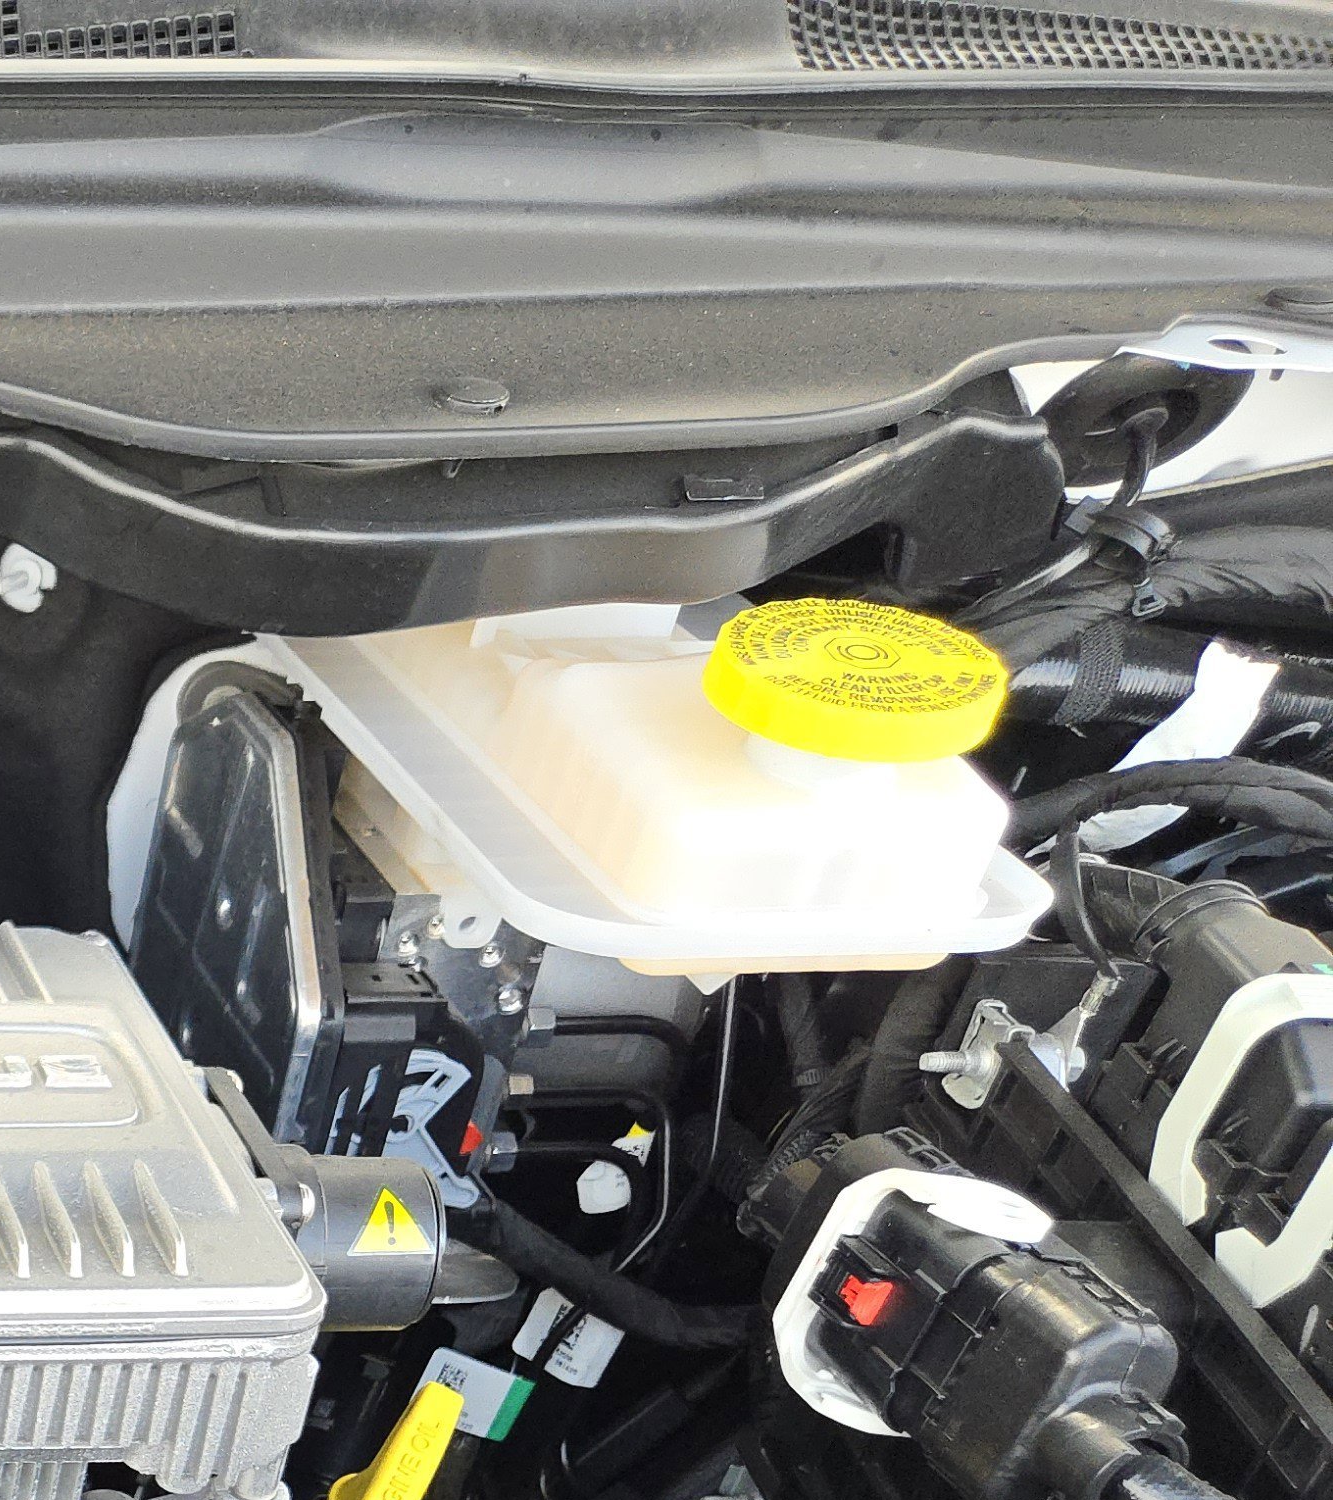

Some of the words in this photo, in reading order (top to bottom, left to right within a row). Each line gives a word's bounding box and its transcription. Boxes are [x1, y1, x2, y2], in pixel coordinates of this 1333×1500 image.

[824, 599, 897, 615] BOUCHON
[792, 616, 820, 629] DOT
[832, 616, 925, 644] PROVENANT
[823, 608, 889, 623] UTILISER
[892, 617, 968, 657] UNIQUEMENT
[783, 673, 843, 698] BEFORE
[936, 685, 961, 699] USE
[951, 671, 975, 688] ONLY
[820, 677, 871, 695] CLEAN
[876, 681, 925, 696] FILLER
[921, 673, 946, 689] CAP
[842, 671, 919, 685] WARNING
[763, 674, 794, 690] DOT
[803, 688, 847, 706] FLUID
[850, 700, 895, 713] FROM
[898, 703, 911, 714] A
[913, 699, 963, 714] SEALED
[958, 673, 997, 704] CONTAINER
[410, 1421, 441, 1453] OIL
